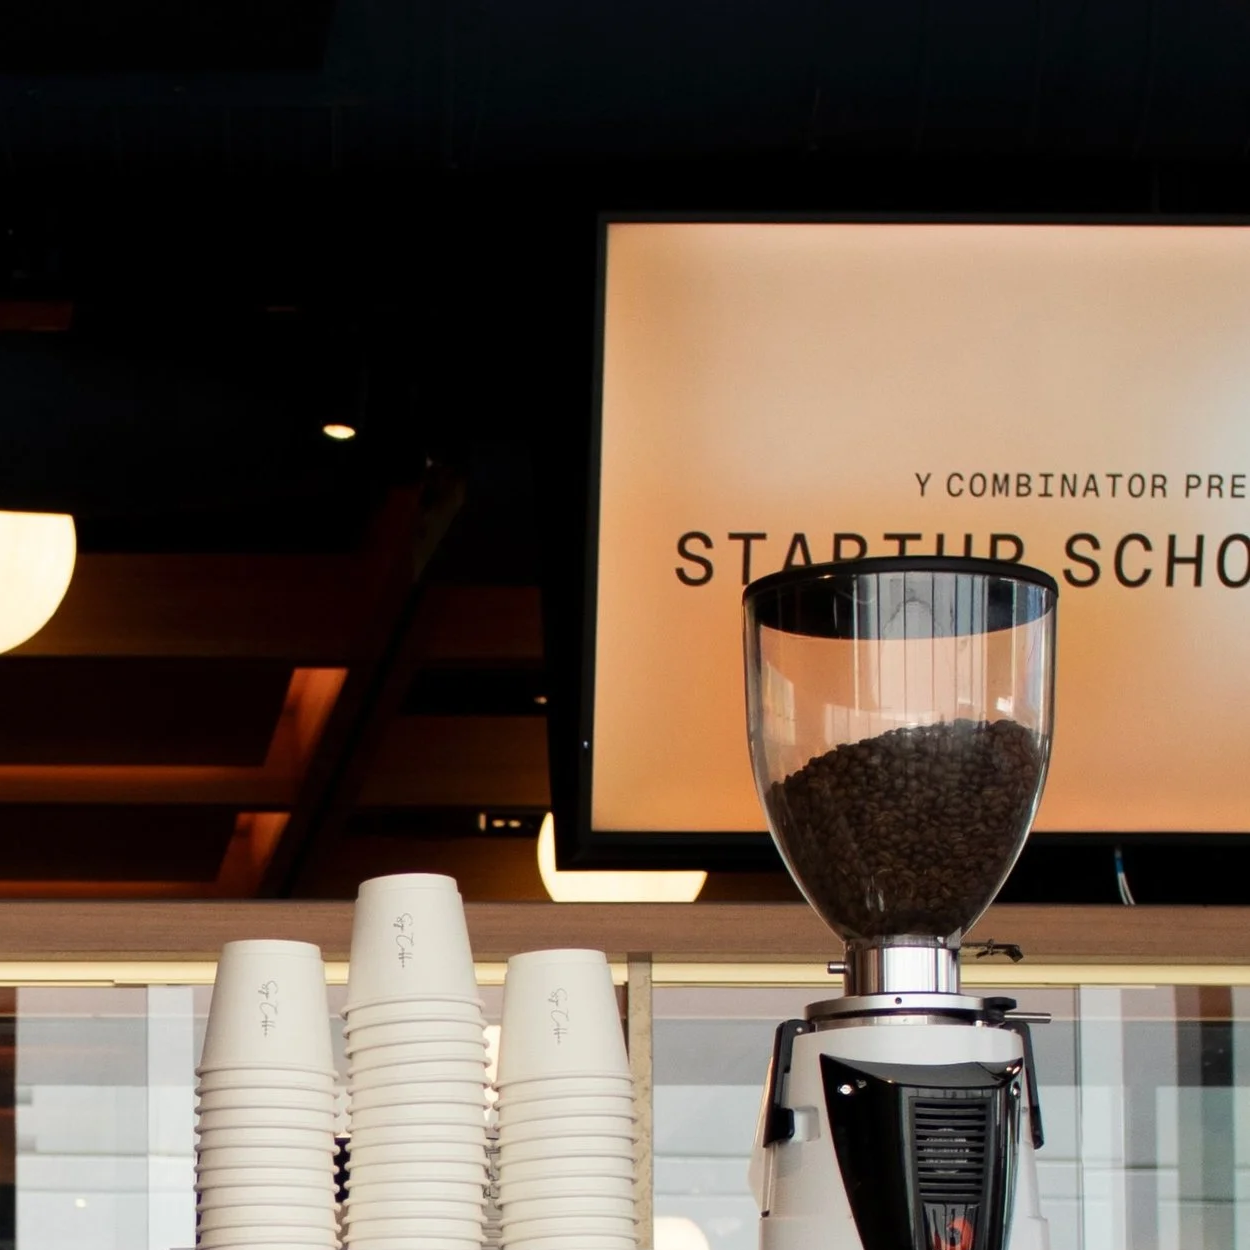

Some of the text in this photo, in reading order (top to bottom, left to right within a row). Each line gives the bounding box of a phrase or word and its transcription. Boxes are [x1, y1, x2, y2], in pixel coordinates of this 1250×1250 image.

[914, 471, 1247, 499] Y COMBINATOR PRE
[1062, 532, 1250, 589] SCHO
